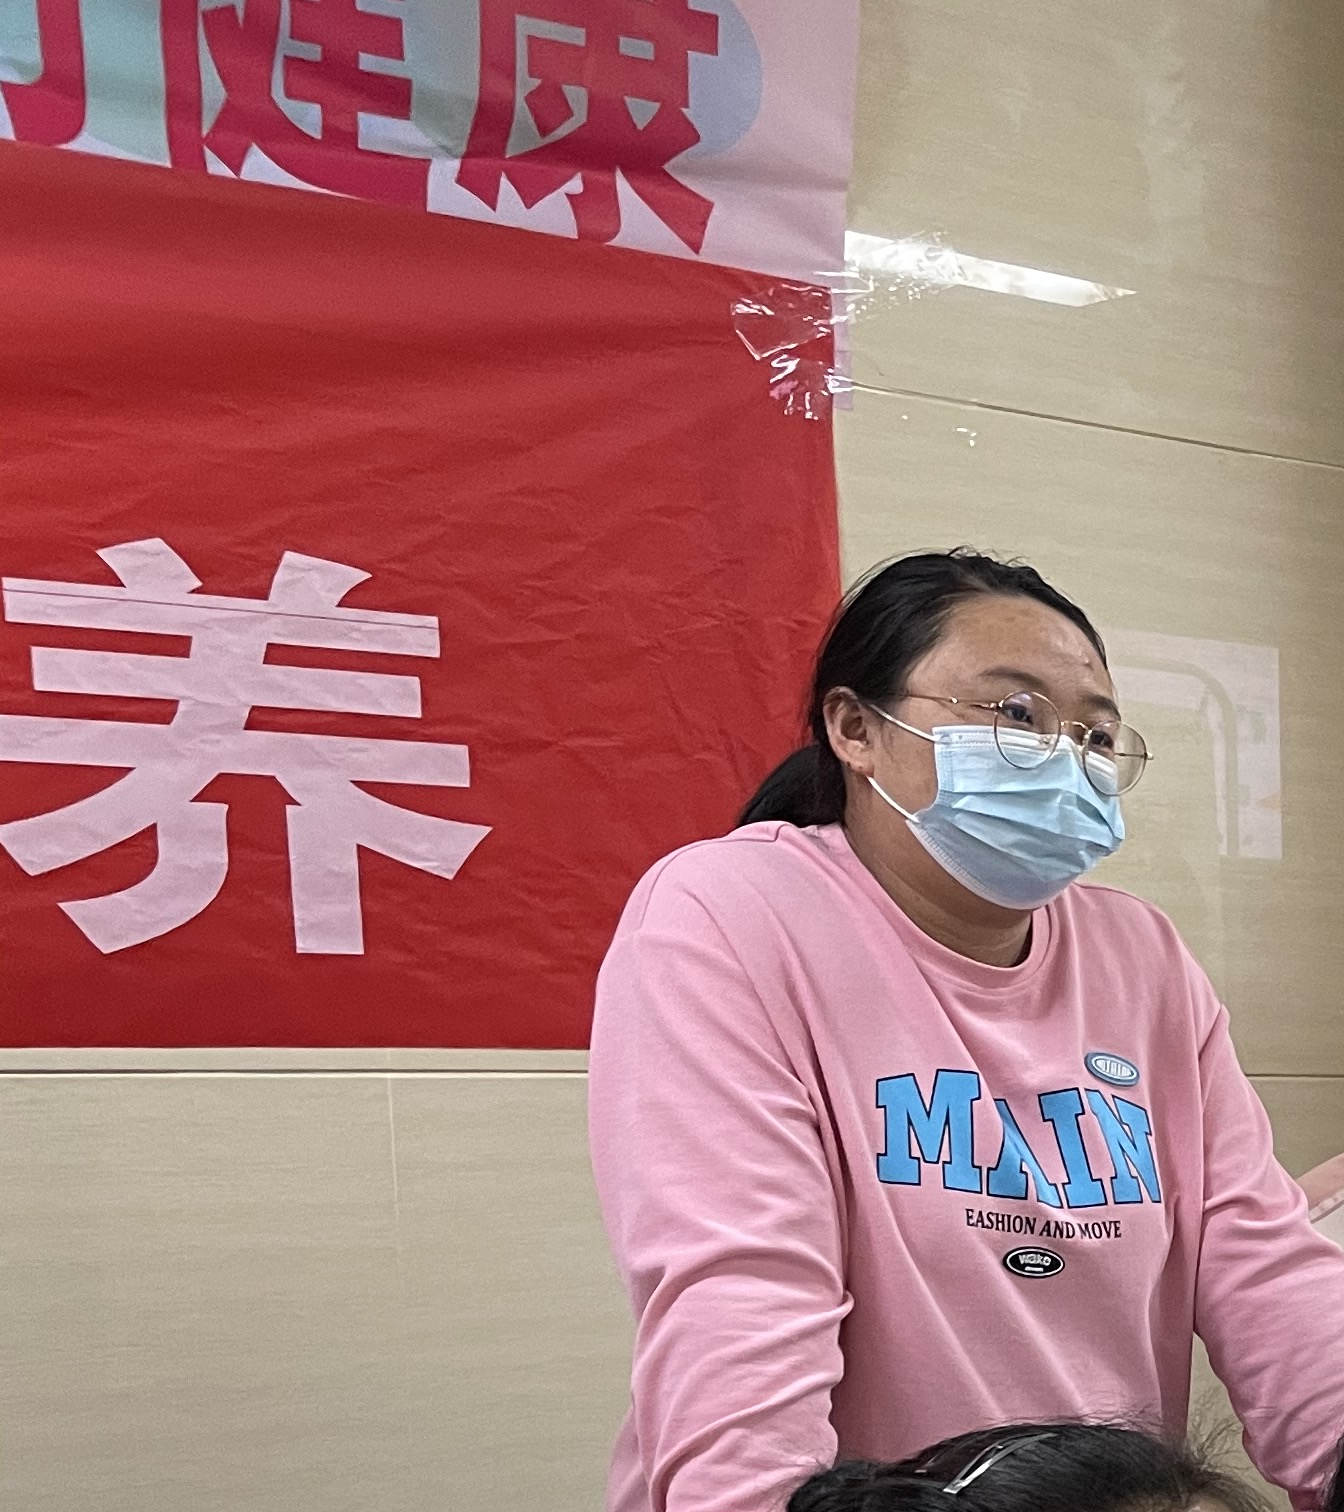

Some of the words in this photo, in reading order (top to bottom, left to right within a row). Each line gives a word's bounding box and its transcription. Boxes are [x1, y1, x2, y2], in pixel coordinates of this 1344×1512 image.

[0, 538, 492, 954] 养
[877, 1069, 1162, 1208] MAIN
[1039, 1220, 1076, 1239] AND
[1078, 1221, 1122, 1239] MOVE
